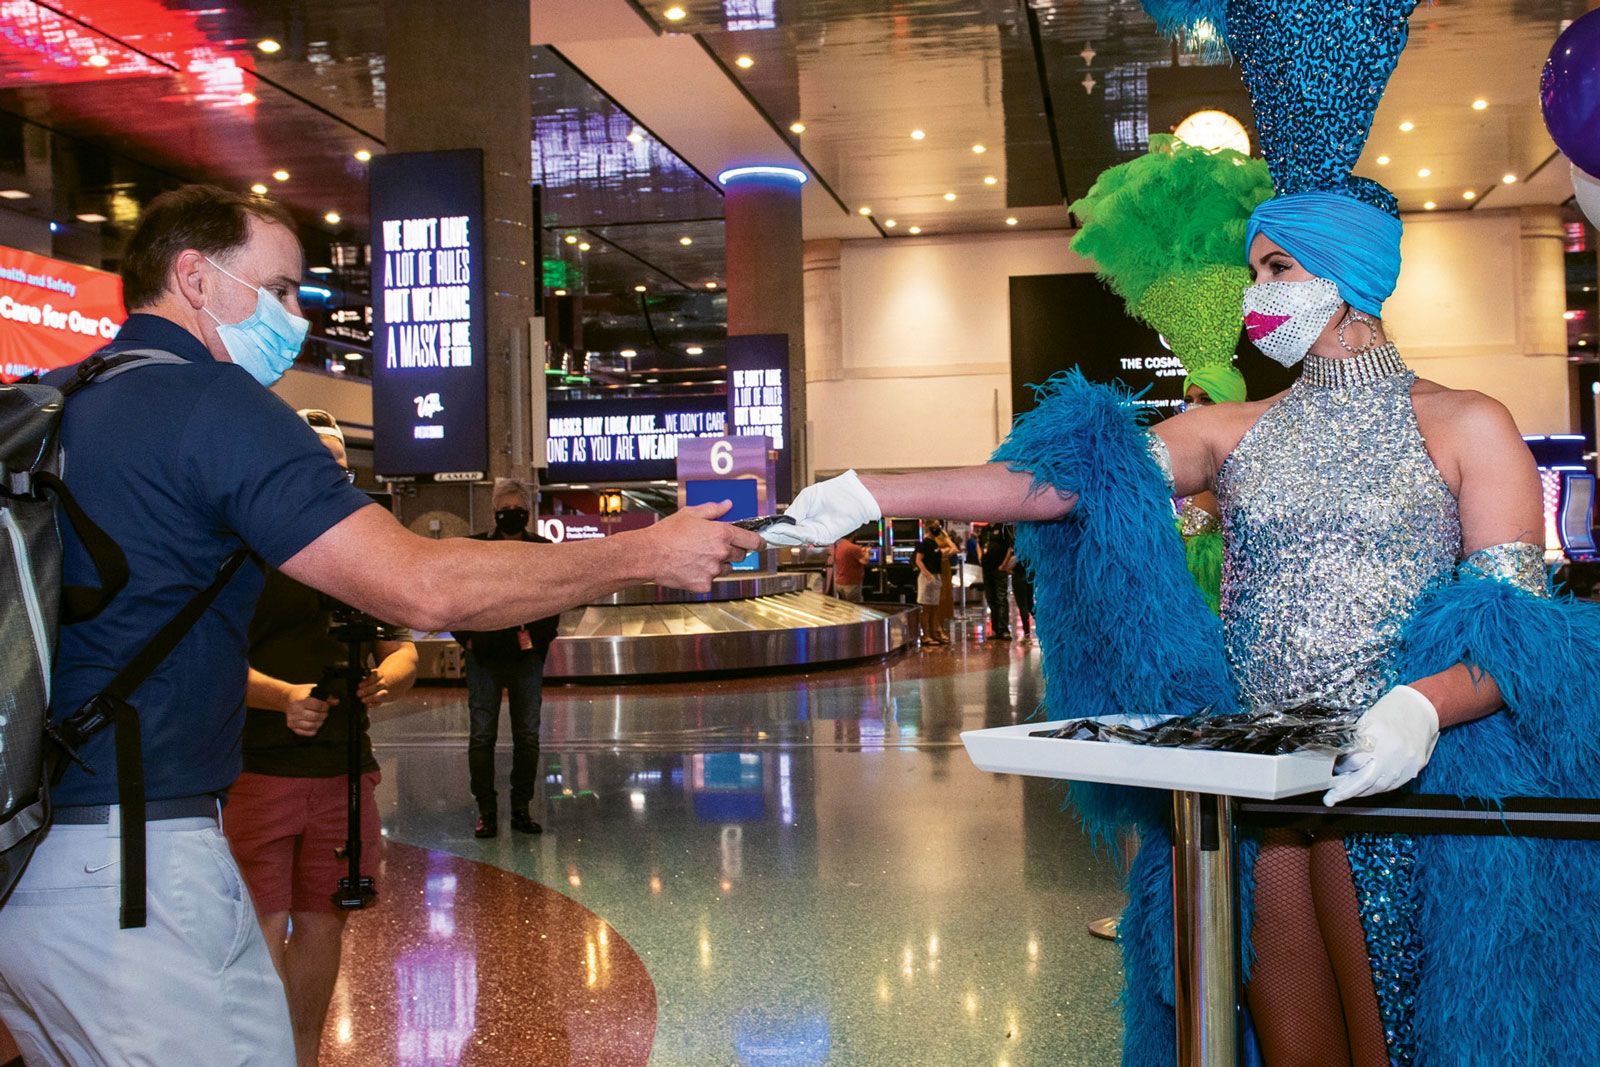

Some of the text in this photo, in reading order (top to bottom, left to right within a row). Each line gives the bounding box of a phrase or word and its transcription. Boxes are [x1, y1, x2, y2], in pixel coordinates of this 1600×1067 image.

[383, 220, 402, 251] WE
[403, 218, 437, 250] DON'T
[0, 266, 76, 298] ealth and Safety
[384, 253, 393, 287] A
[396, 252, 415, 287] LOT
[418, 251, 432, 286] OF
[436, 248, 470, 284] RULES
[0, 295, 41, 324] Care
[42, 304, 67, 329] for
[69, 310, 99, 336] Our
[384, 285, 471, 323] BUT WEARING
[386, 325, 397, 368] A
[400, 324, 439, 368] MASK
[1120, 356, 1184, 369] THE COSM
[549, 417, 582, 437] MASKS
[582, 416, 603, 436] MAY
[604, 415, 629, 435] LOOK
[680, 412, 704, 432] DON'T
[705, 411, 726, 431] CARE
[546, 436, 569, 463] ONG
[572, 436, 587, 462] AS
[589, 435, 612, 462] YOU
[615, 435, 636, 461] ARE
[710, 440, 734, 475] 6
